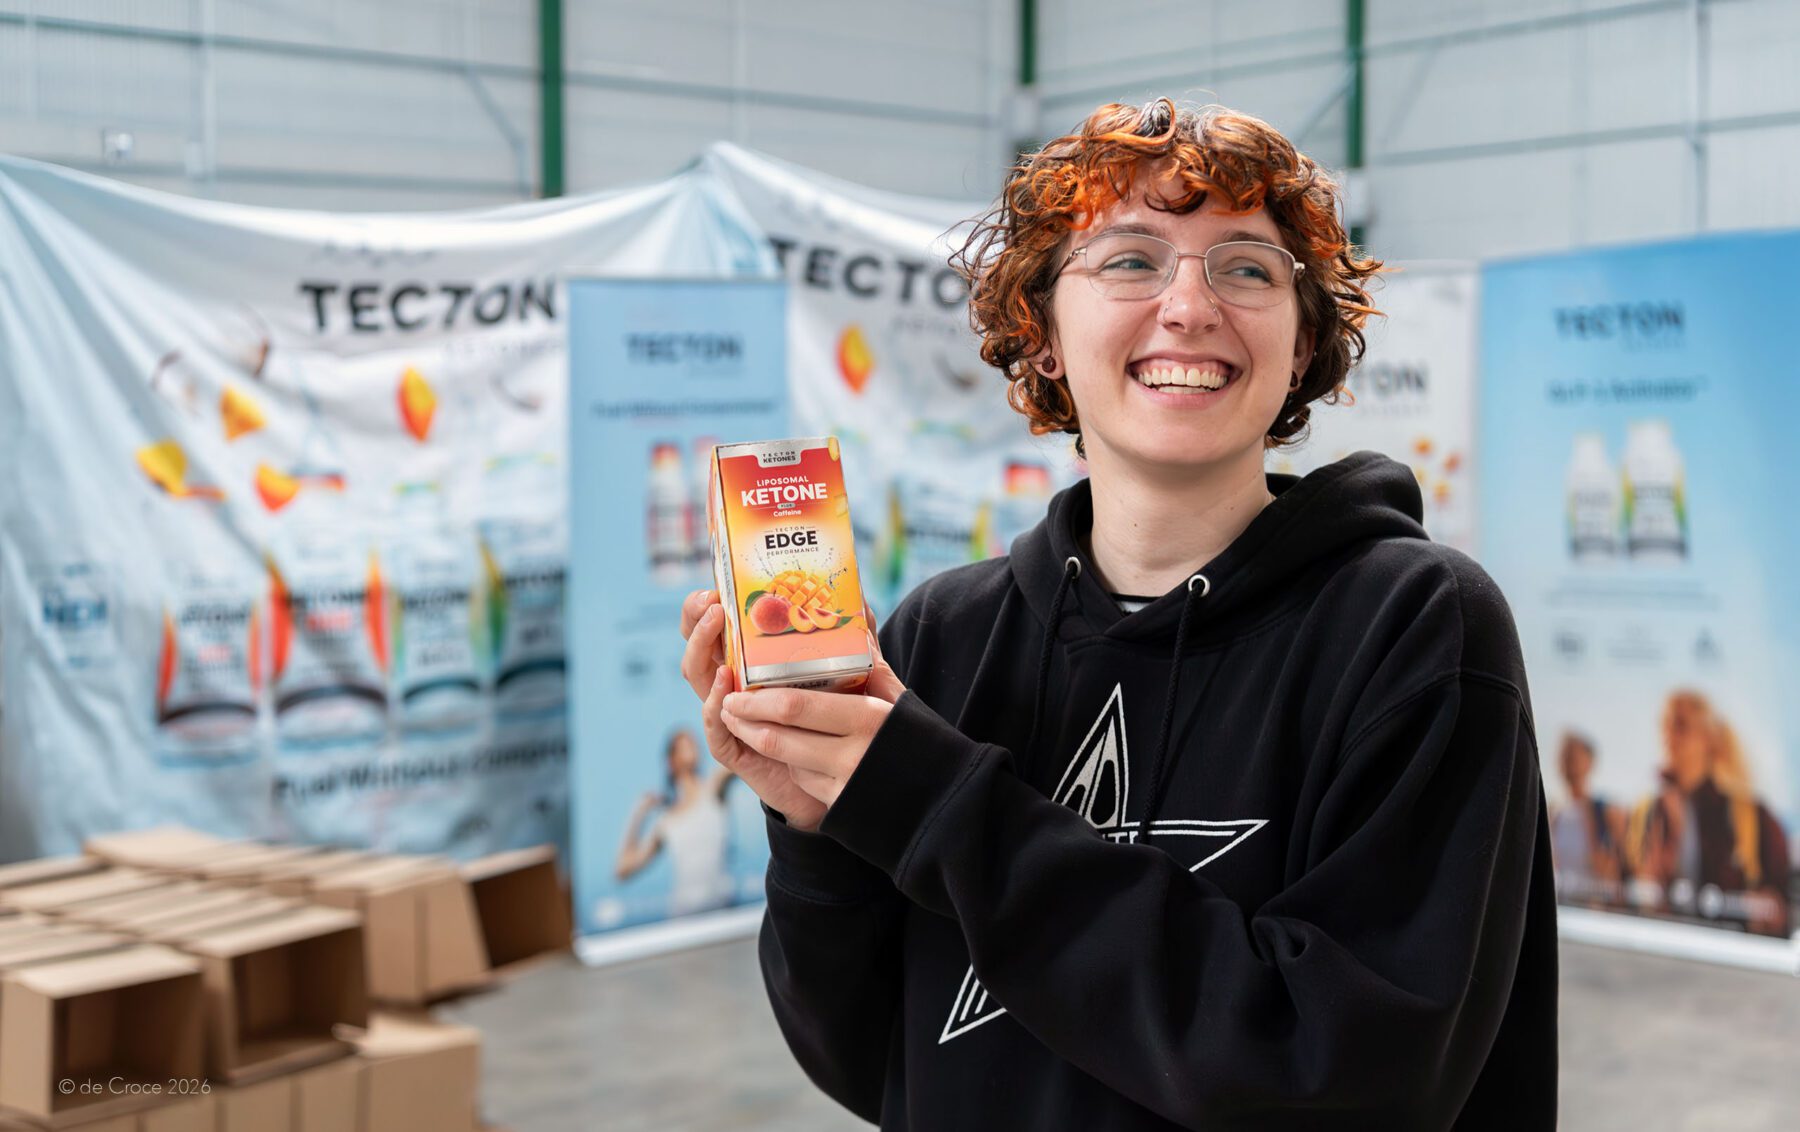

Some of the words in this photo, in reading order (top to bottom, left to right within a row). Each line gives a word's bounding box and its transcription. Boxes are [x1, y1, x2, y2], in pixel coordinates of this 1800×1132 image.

[767, 237, 968, 309] TECTO
[298, 277, 556, 333] TECTON
[1553, 301, 1686, 340] TECTON
[763, 455, 796, 463] KETONES
[757, 475, 809, 487] LIPOSOMAL
[741, 483, 828, 507] KETONE
[773, 509, 802, 517] Caffeine
[765, 530, 818, 549] EDGE
[767, 547, 819, 557] PERFORMANCE
